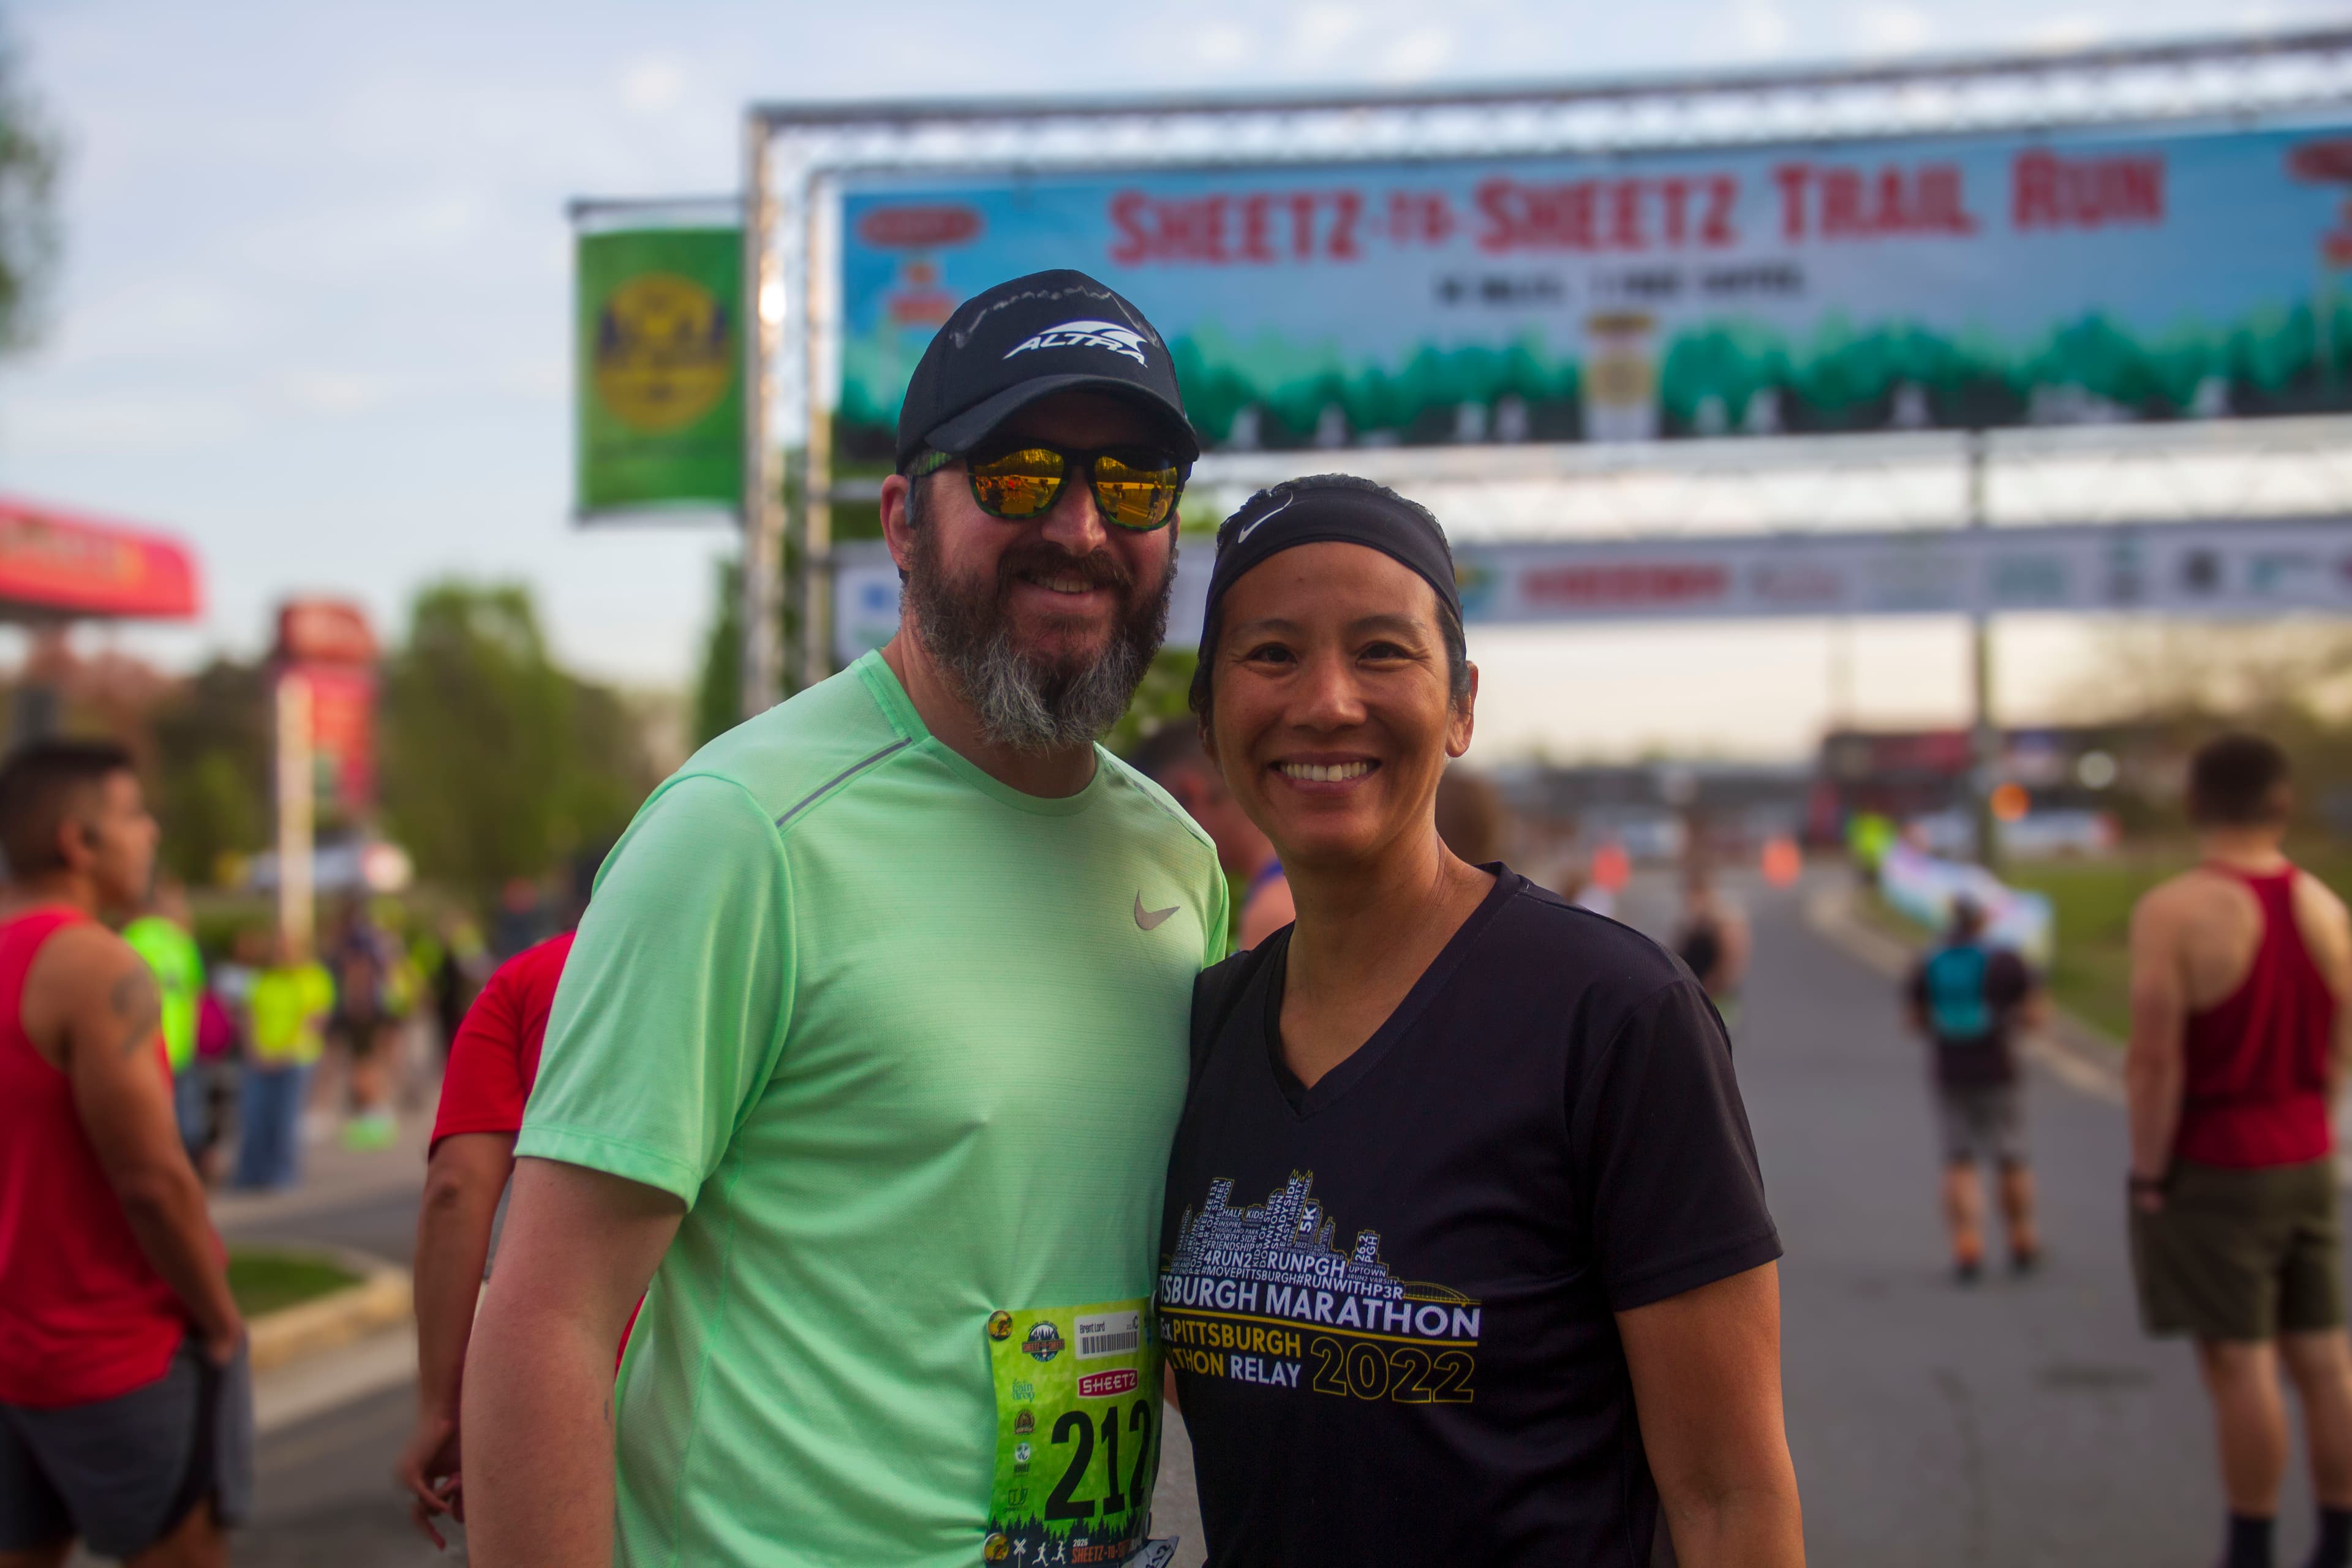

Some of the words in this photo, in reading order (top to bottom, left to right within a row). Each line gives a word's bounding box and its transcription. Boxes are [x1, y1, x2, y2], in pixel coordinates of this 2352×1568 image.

[1770, 161, 1978, 239] TRAIL
[2012, 149, 2165, 230] RUN
[1003, 331, 1148, 368] ALTRA
[1189, 1242, 1201, 1274] POINT
[1198, 1199, 1213, 1237] BREEZE
[1210, 1180, 1219, 1196] 13.1
[1209, 1181, 1231, 1240] HOMEWOOD
[1221, 1208, 1243, 1218] HALF
[1246, 1210, 1264, 1219] KIDS
[1271, 1178, 1297, 1250] SHADYSIDE
[1280, 1222, 1291, 1247] EAST
[1287, 1182, 1303, 1220] LIBERTY
[1287, 1226, 1297, 1246] STEEL
[1294, 1178, 1311, 1224] CHALLENGE
[1299, 1207, 1317, 1233] 5K
[1194, 1231, 1210, 1275] RUNNER
[1207, 1214, 1215, 1227] OF
[1212, 1182, 1226, 1211] STEEL
[1207, 1240, 1255, 1251] FRIENDSHIP
[1214, 1233, 1240, 1242] NORTH
[1251, 1243, 1262, 1267] KIDS
[1259, 1226, 1267, 1239] OF
[1264, 1193, 1277, 1223] STEEL
[1259, 1195, 1284, 1268] DOWNTOWN
[1204, 1250, 1252, 1267] 4RUN2
[1267, 1251, 1346, 1279] RUNPGH
[1355, 1235, 1368, 1262] 26.2
[1364, 1236, 1378, 1263] PGH
[1349, 1265, 1386, 1277] UPTOWN
[1370, 1276, 1397, 1286] VARSITY
[1265, 1284, 1480, 1338] MARATHON
[1173, 1319, 1300, 1358] PITTSBURGH
[1083, 1373, 1136, 1393] SHEETZ
[1231, 1355, 1301, 1387] RELAY
[1311, 1336, 1474, 1403] 2022
[1044, 1399, 1151, 1521] 212
[1071, 1545, 1104, 1564] SHEETZ
